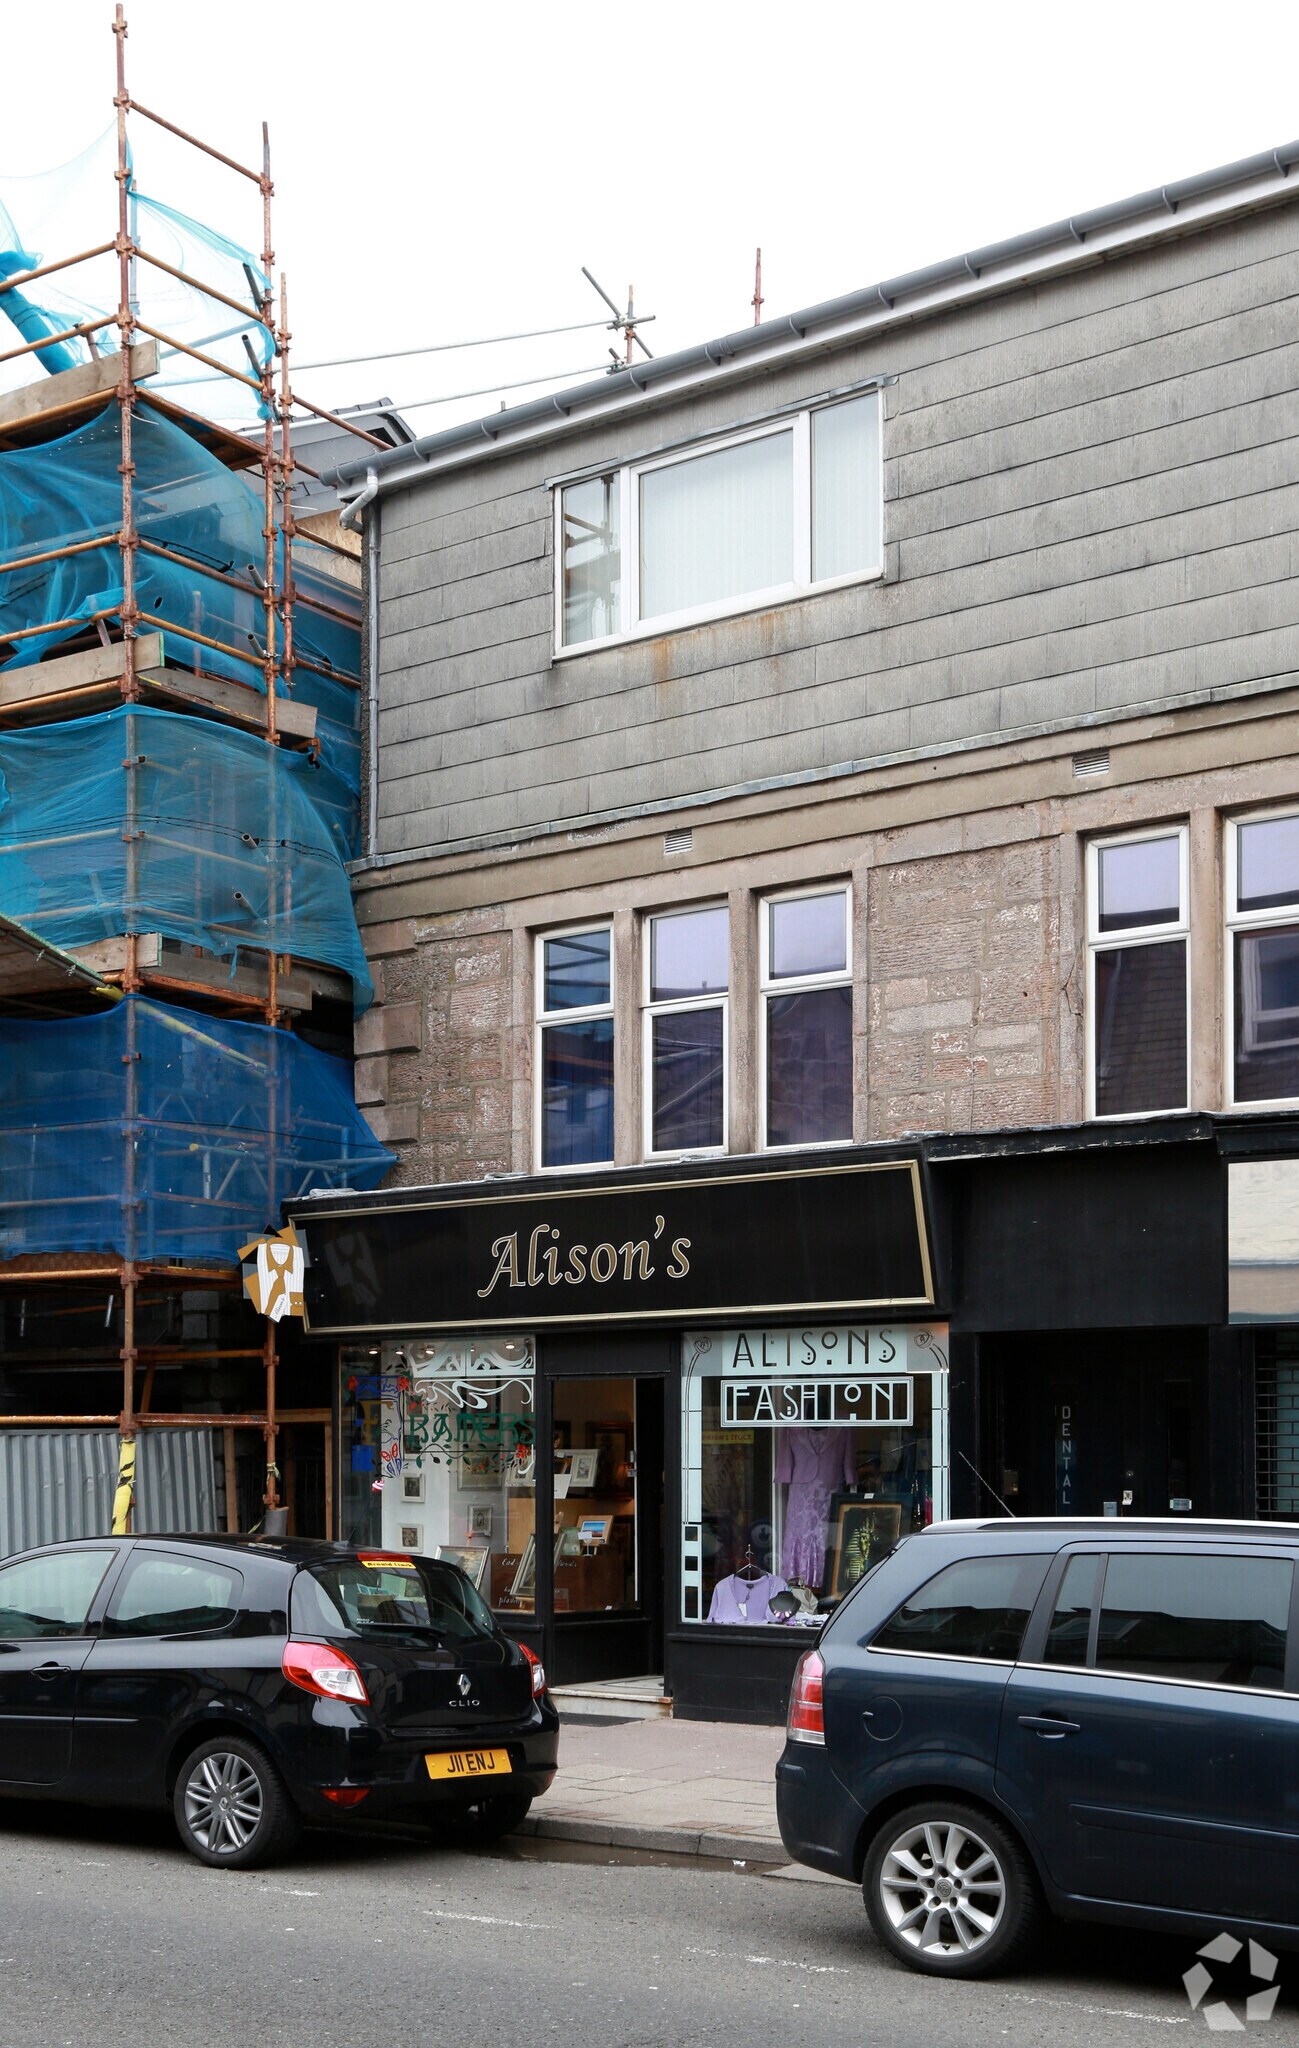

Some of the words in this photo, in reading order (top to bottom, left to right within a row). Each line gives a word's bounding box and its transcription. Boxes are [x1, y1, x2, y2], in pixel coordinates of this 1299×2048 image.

[477, 1215, 692, 1298] Alison's
[732, 1329, 896, 1368] ALISONS
[732, 1382, 894, 1421] FASHION
[1061, 1405, 1072, 1505] DENTAL
[448, 1699, 480, 1707] CLIO
[465, 1752, 495, 1771] ENJ
